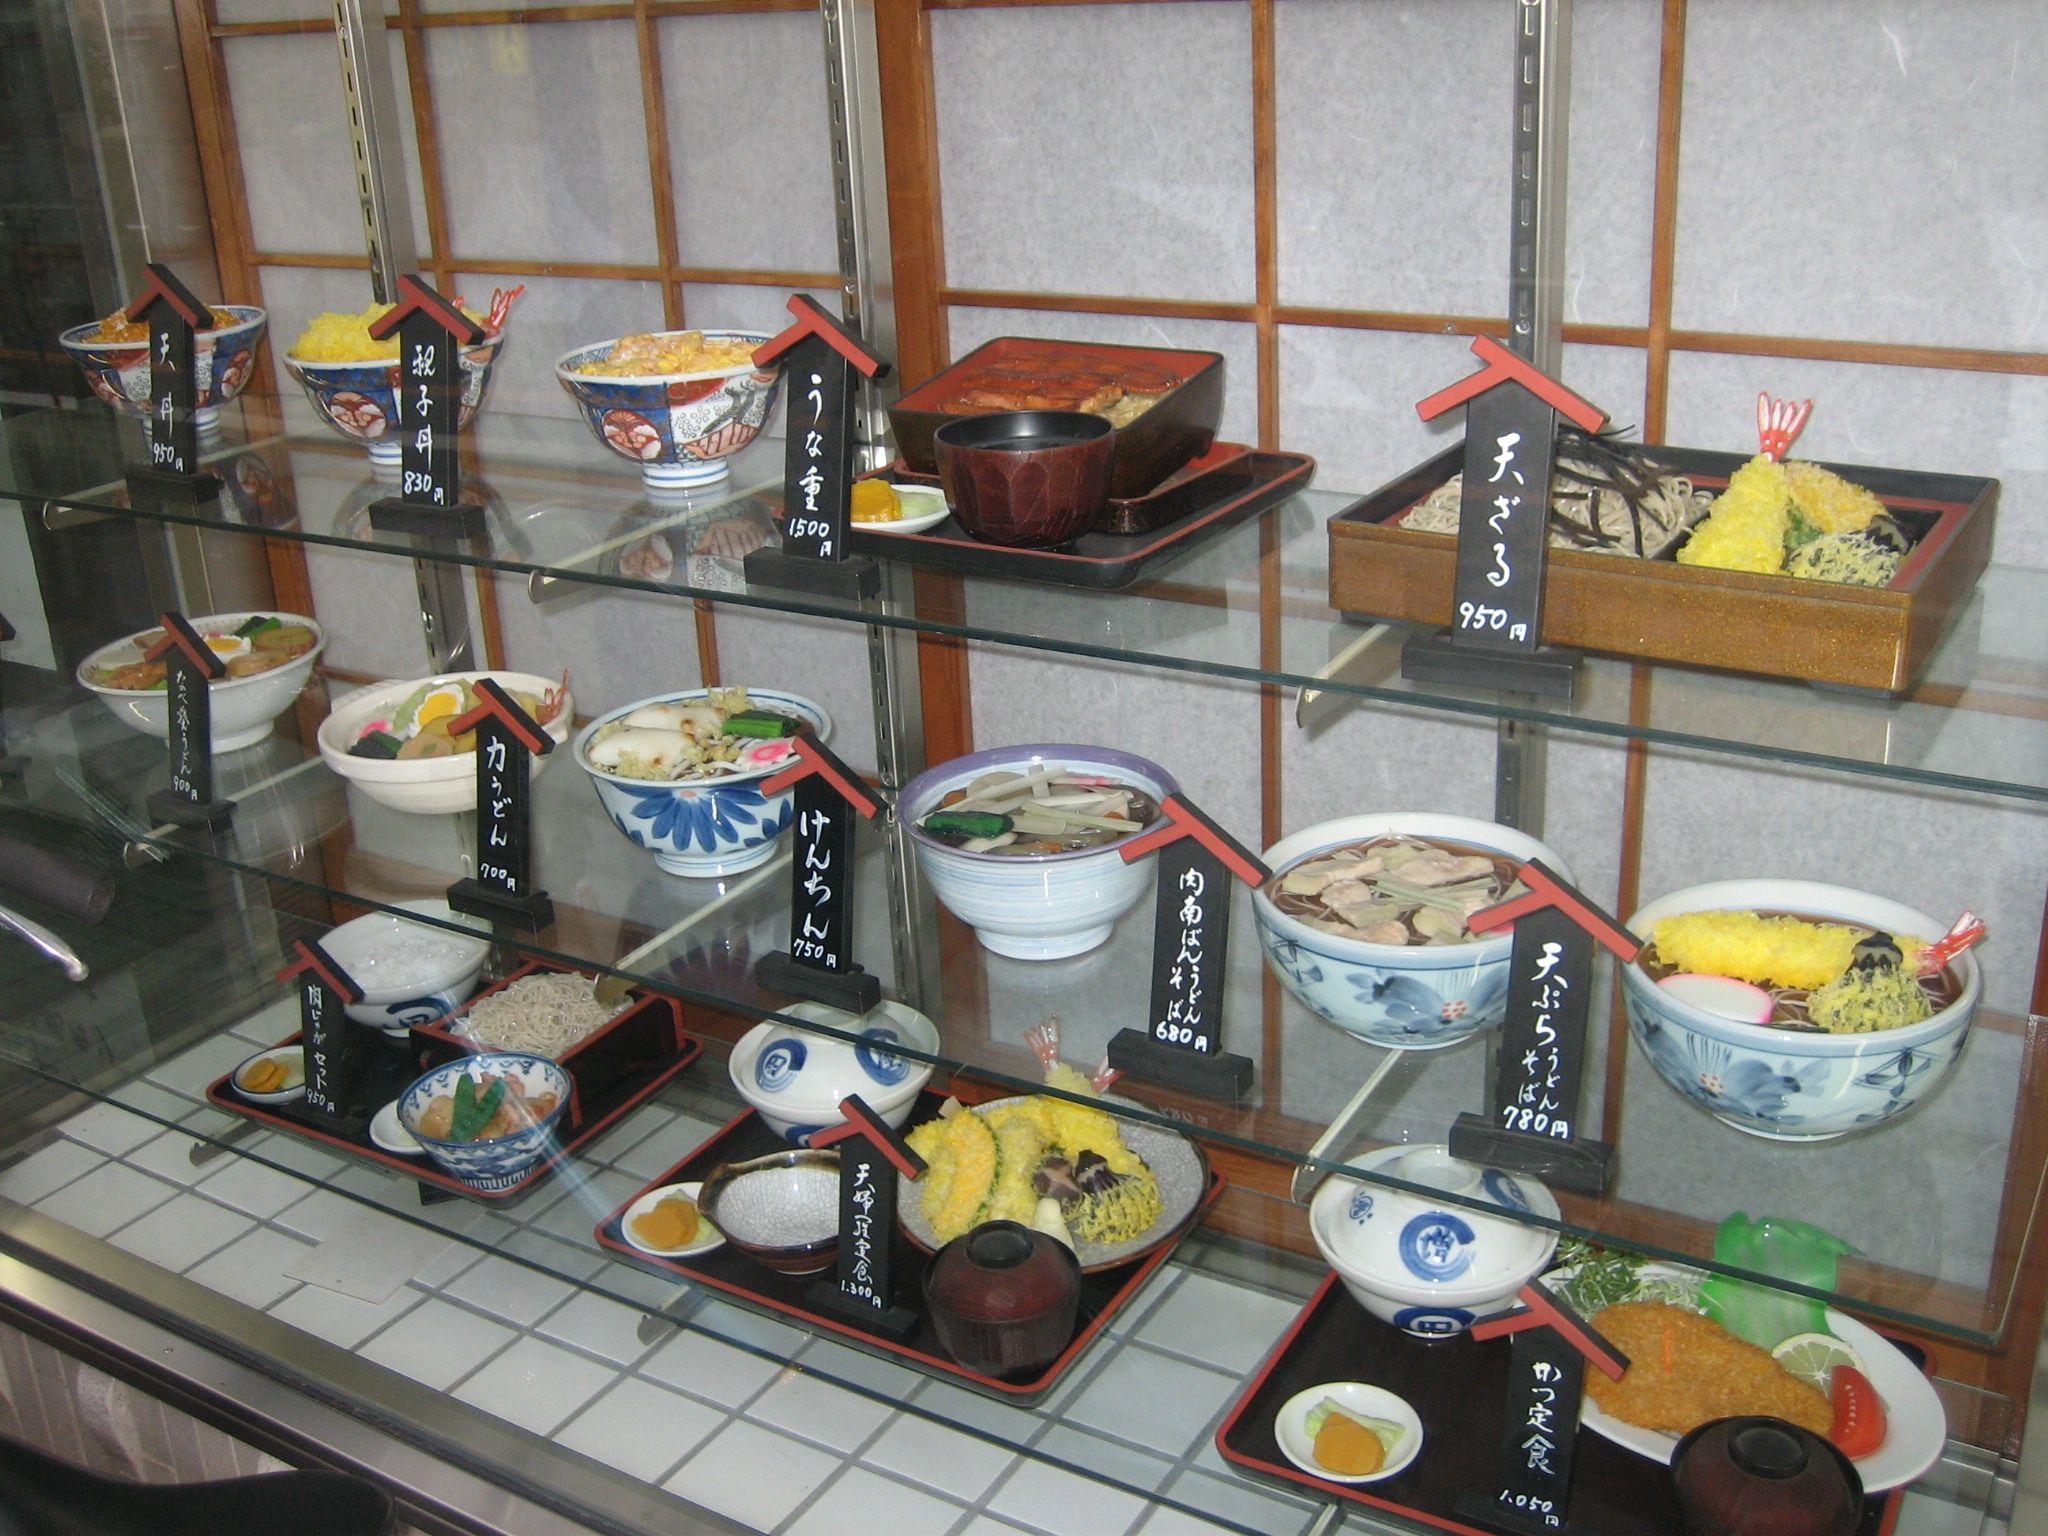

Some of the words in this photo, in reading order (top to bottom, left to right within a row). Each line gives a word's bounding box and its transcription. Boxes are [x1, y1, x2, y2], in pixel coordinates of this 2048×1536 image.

[153, 442, 184, 473] 950円
[799, 373, 825, 512] うな重
[404, 470, 445, 506] 830円
[1486, 432, 1525, 588] 天ざる
[1459, 601, 1528, 643] 950円
[173, 775, 198, 800] 900円
[486, 735, 513, 847] 力うどん
[480, 862, 516, 892] 700円
[800, 809, 832, 940] けんちん
[793, 938, 837, 969] 750円
[1167, 966, 1184, 1023] そば
[1183, 964, 1202, 1025] うどん
[1531, 942, 1569, 1047] 天ぷら
[1156, 1020, 1208, 1053] 680円
[306, 1088, 335, 1113] 950円
[1518, 1049, 1541, 1105] そば
[1539, 1046, 1561, 1111] うどん
[1503, 1105, 1569, 1140] 780円
[1521, 1361, 1563, 1475] かつ定食
